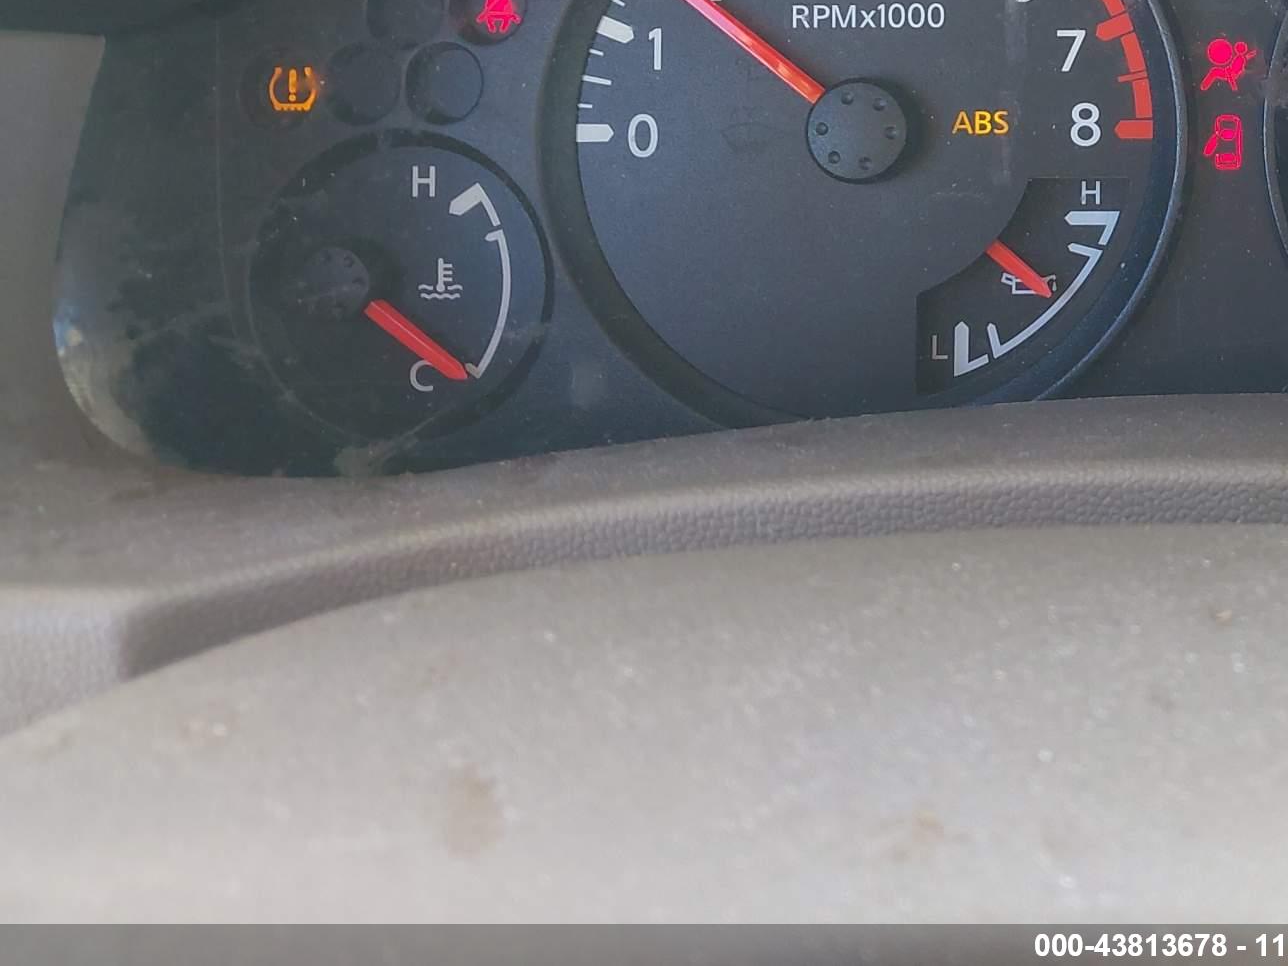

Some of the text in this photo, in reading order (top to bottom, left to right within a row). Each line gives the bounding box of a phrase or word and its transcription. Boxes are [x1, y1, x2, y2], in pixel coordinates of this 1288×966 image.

[790, 3, 946, 29] RPMx1000
[647, 27, 663, 70] 1
[1056, 29, 1086, 72] 7
[627, 113, 659, 158] 0
[951, 110, 1010, 135] ABS
[1070, 102, 1101, 146] 8
[411, 165, 436, 198] H
[1080, 181, 1101, 205] H
[931, 334, 948, 360] L
[409, 360, 435, 392] C
